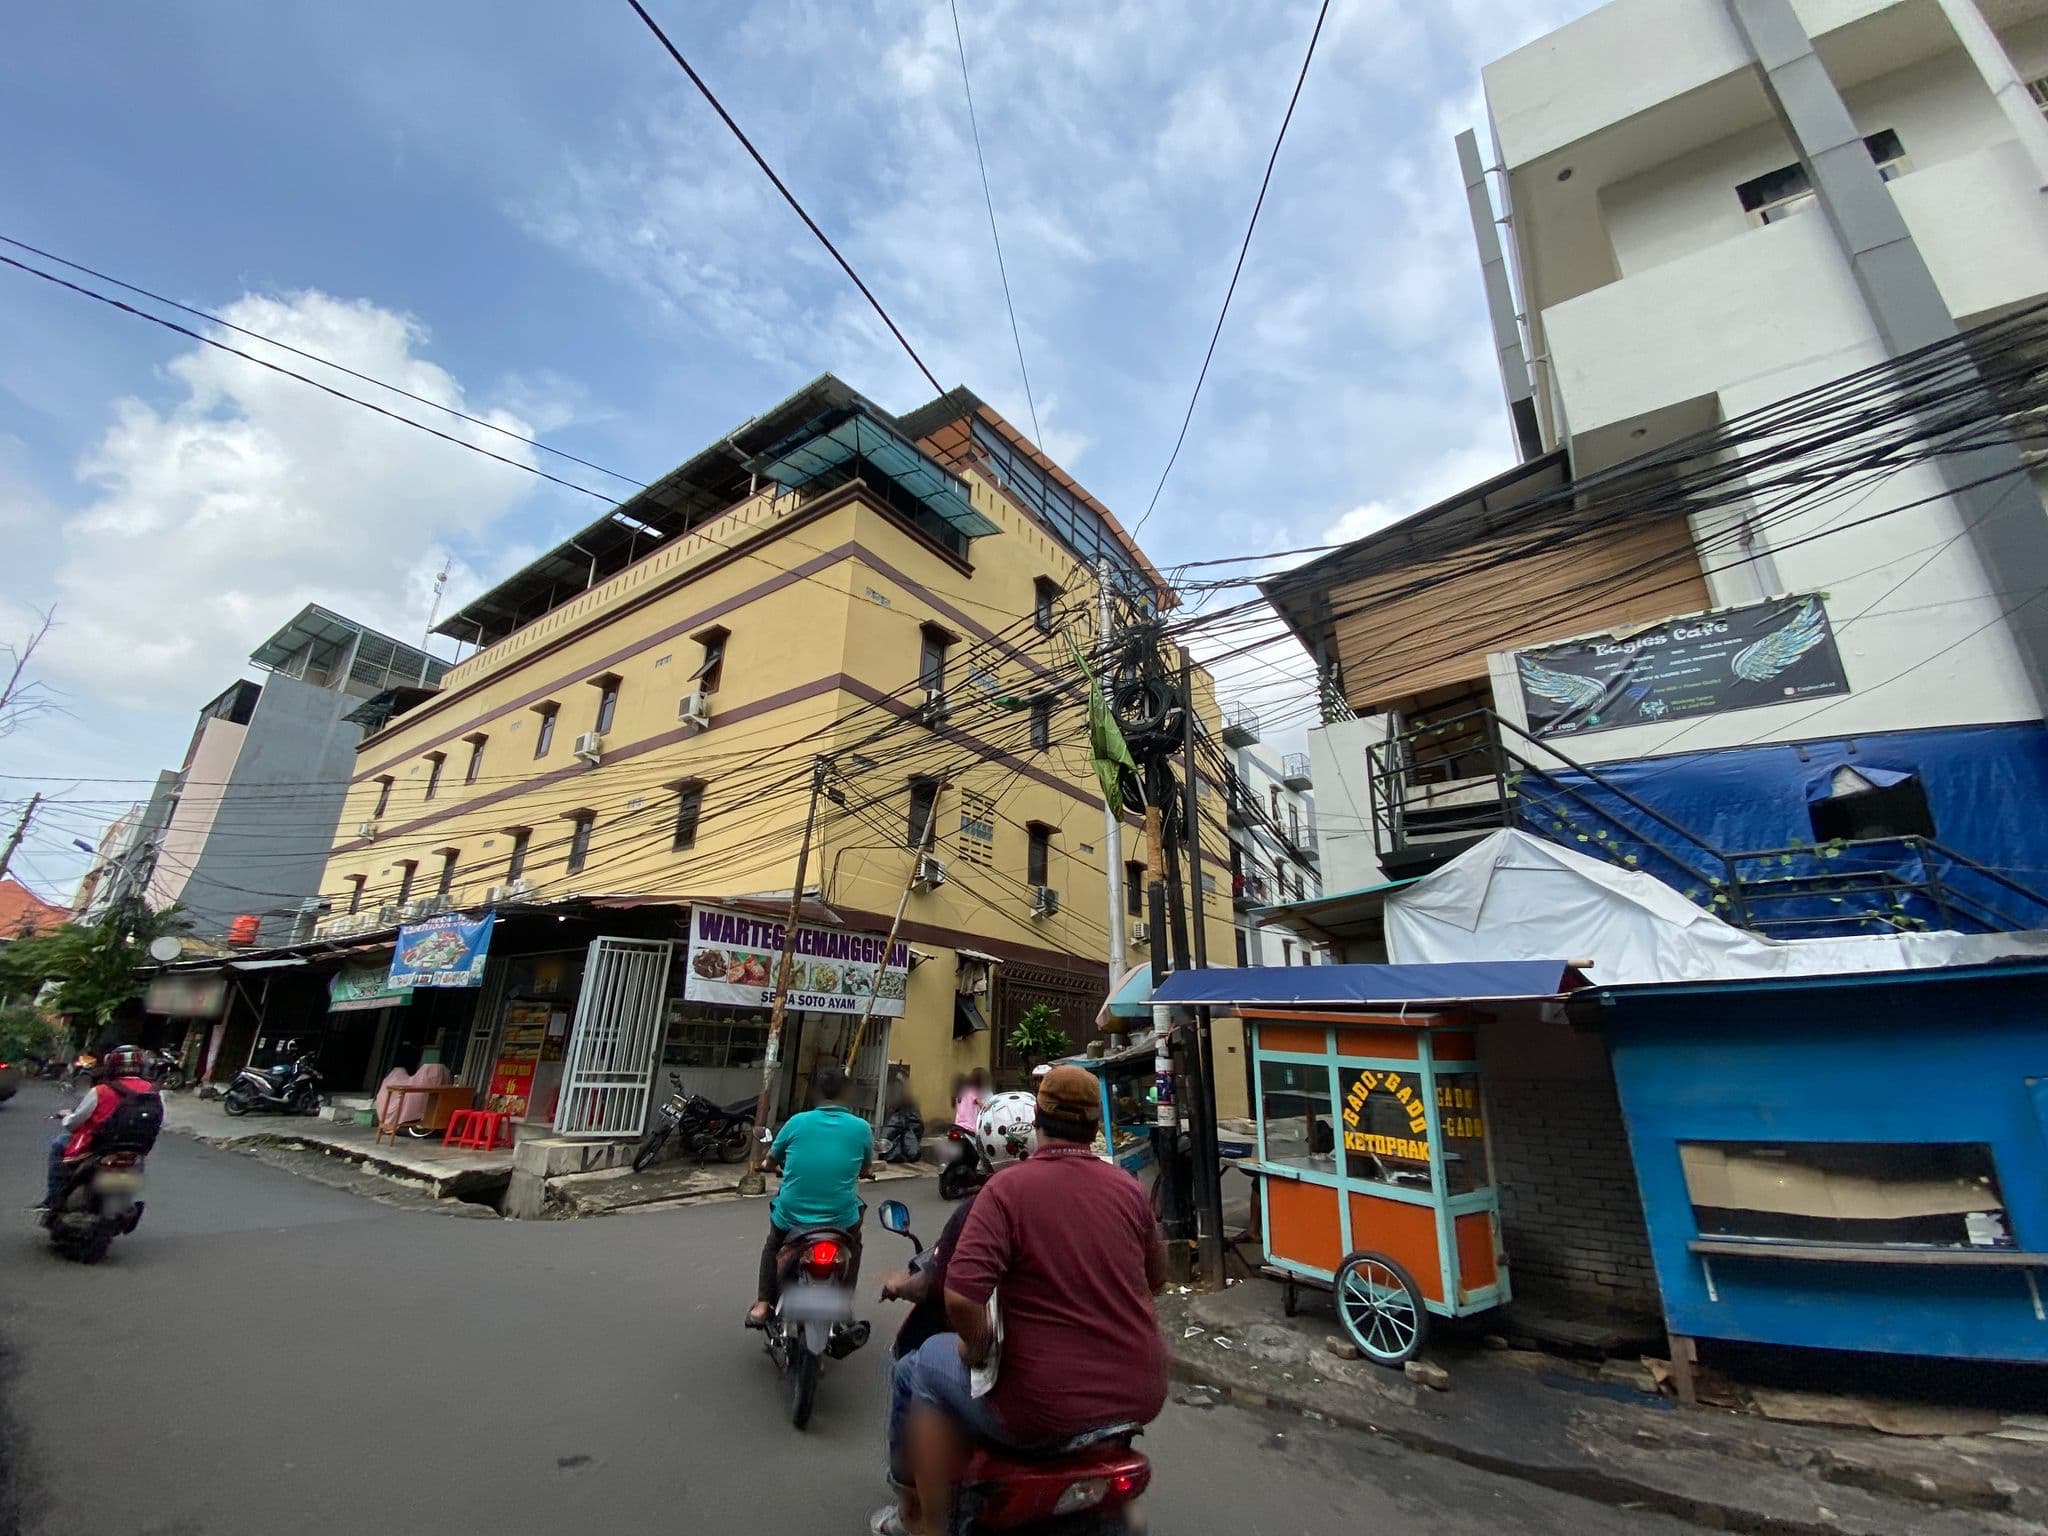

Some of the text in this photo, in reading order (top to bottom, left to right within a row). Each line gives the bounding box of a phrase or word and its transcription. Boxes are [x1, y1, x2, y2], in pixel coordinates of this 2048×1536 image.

[699, 911, 907, 968] WARTEG KEMANGGISAN
[761, 991, 856, 1009] SEIA SOTO AYAM
[1344, 1131, 1430, 1161] KETOPRAK
